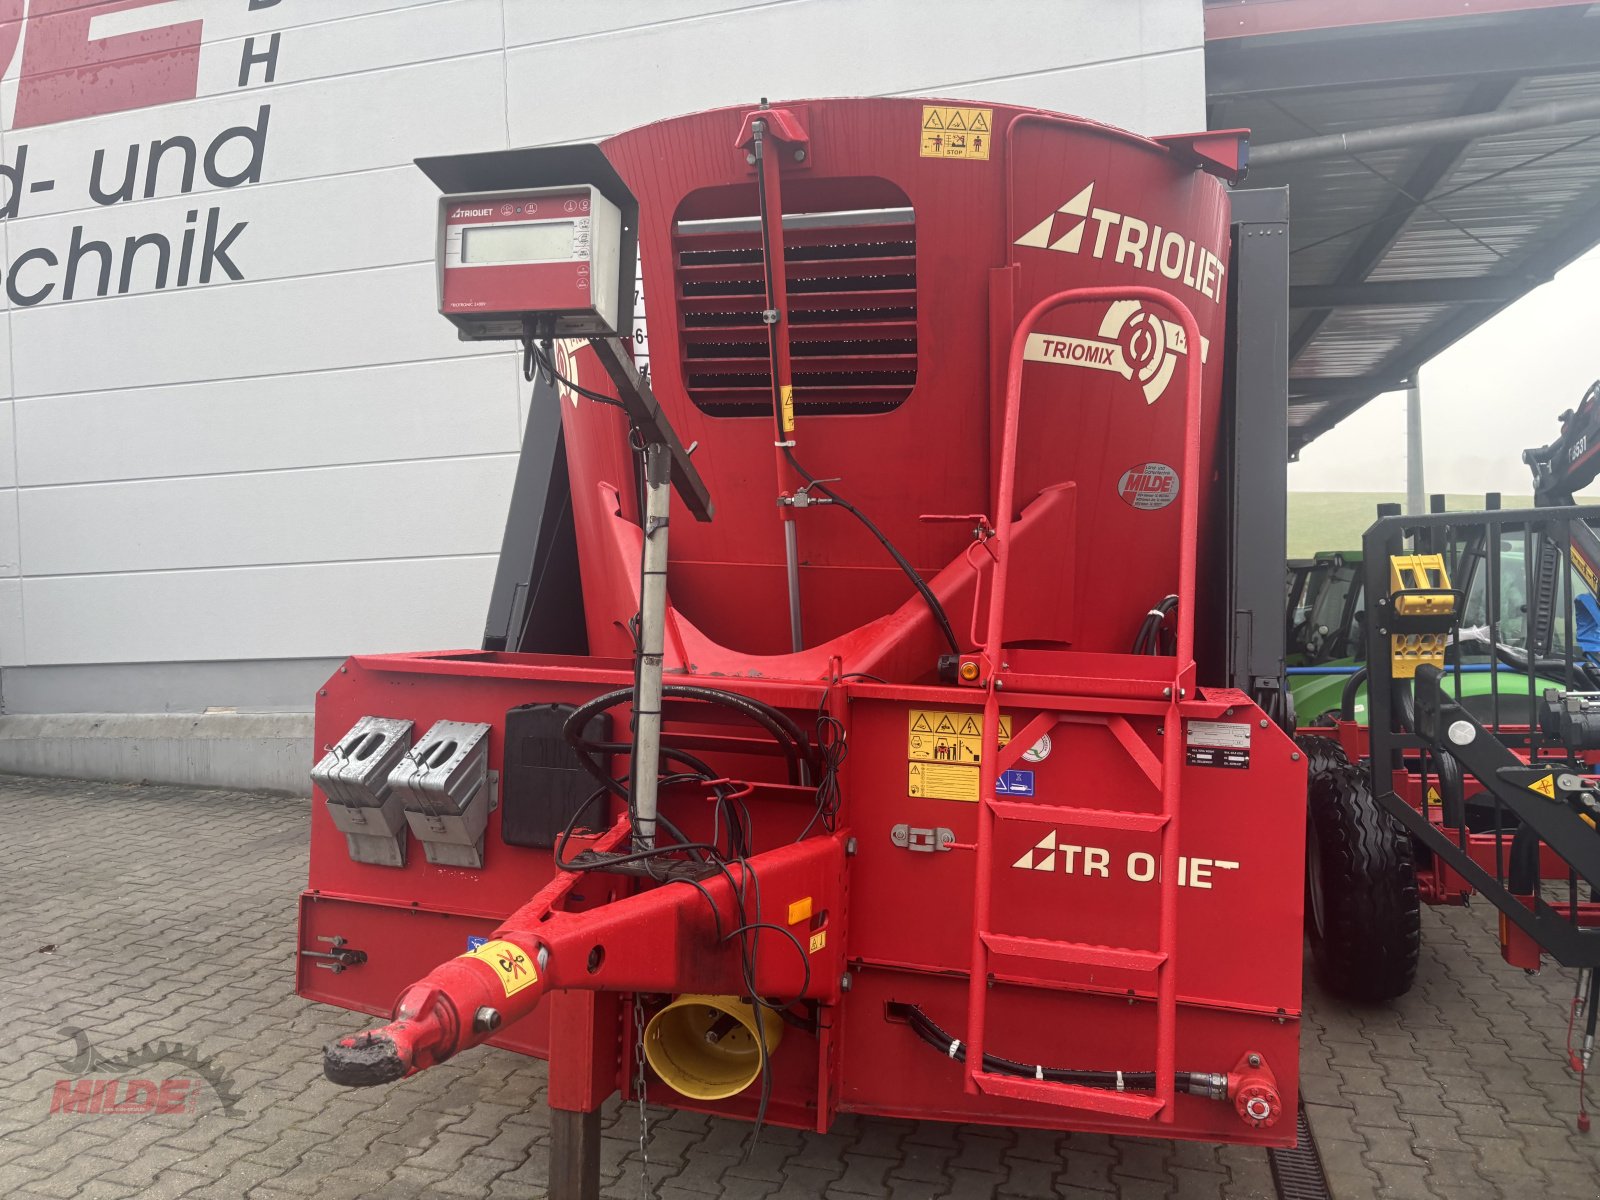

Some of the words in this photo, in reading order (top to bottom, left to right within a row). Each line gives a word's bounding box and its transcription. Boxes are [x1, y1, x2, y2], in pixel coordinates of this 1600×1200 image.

[88, 104, 271, 206] und
[459, 208, 494, 218] TRIOLIET
[0, 206, 249, 307] chnik
[1091, 207, 1225, 304] TRIOLIET
[635, 328, 644, 345] 6
[1042, 340, 1115, 366] TRIOMIX
[1124, 474, 1173, 493] MILDE
